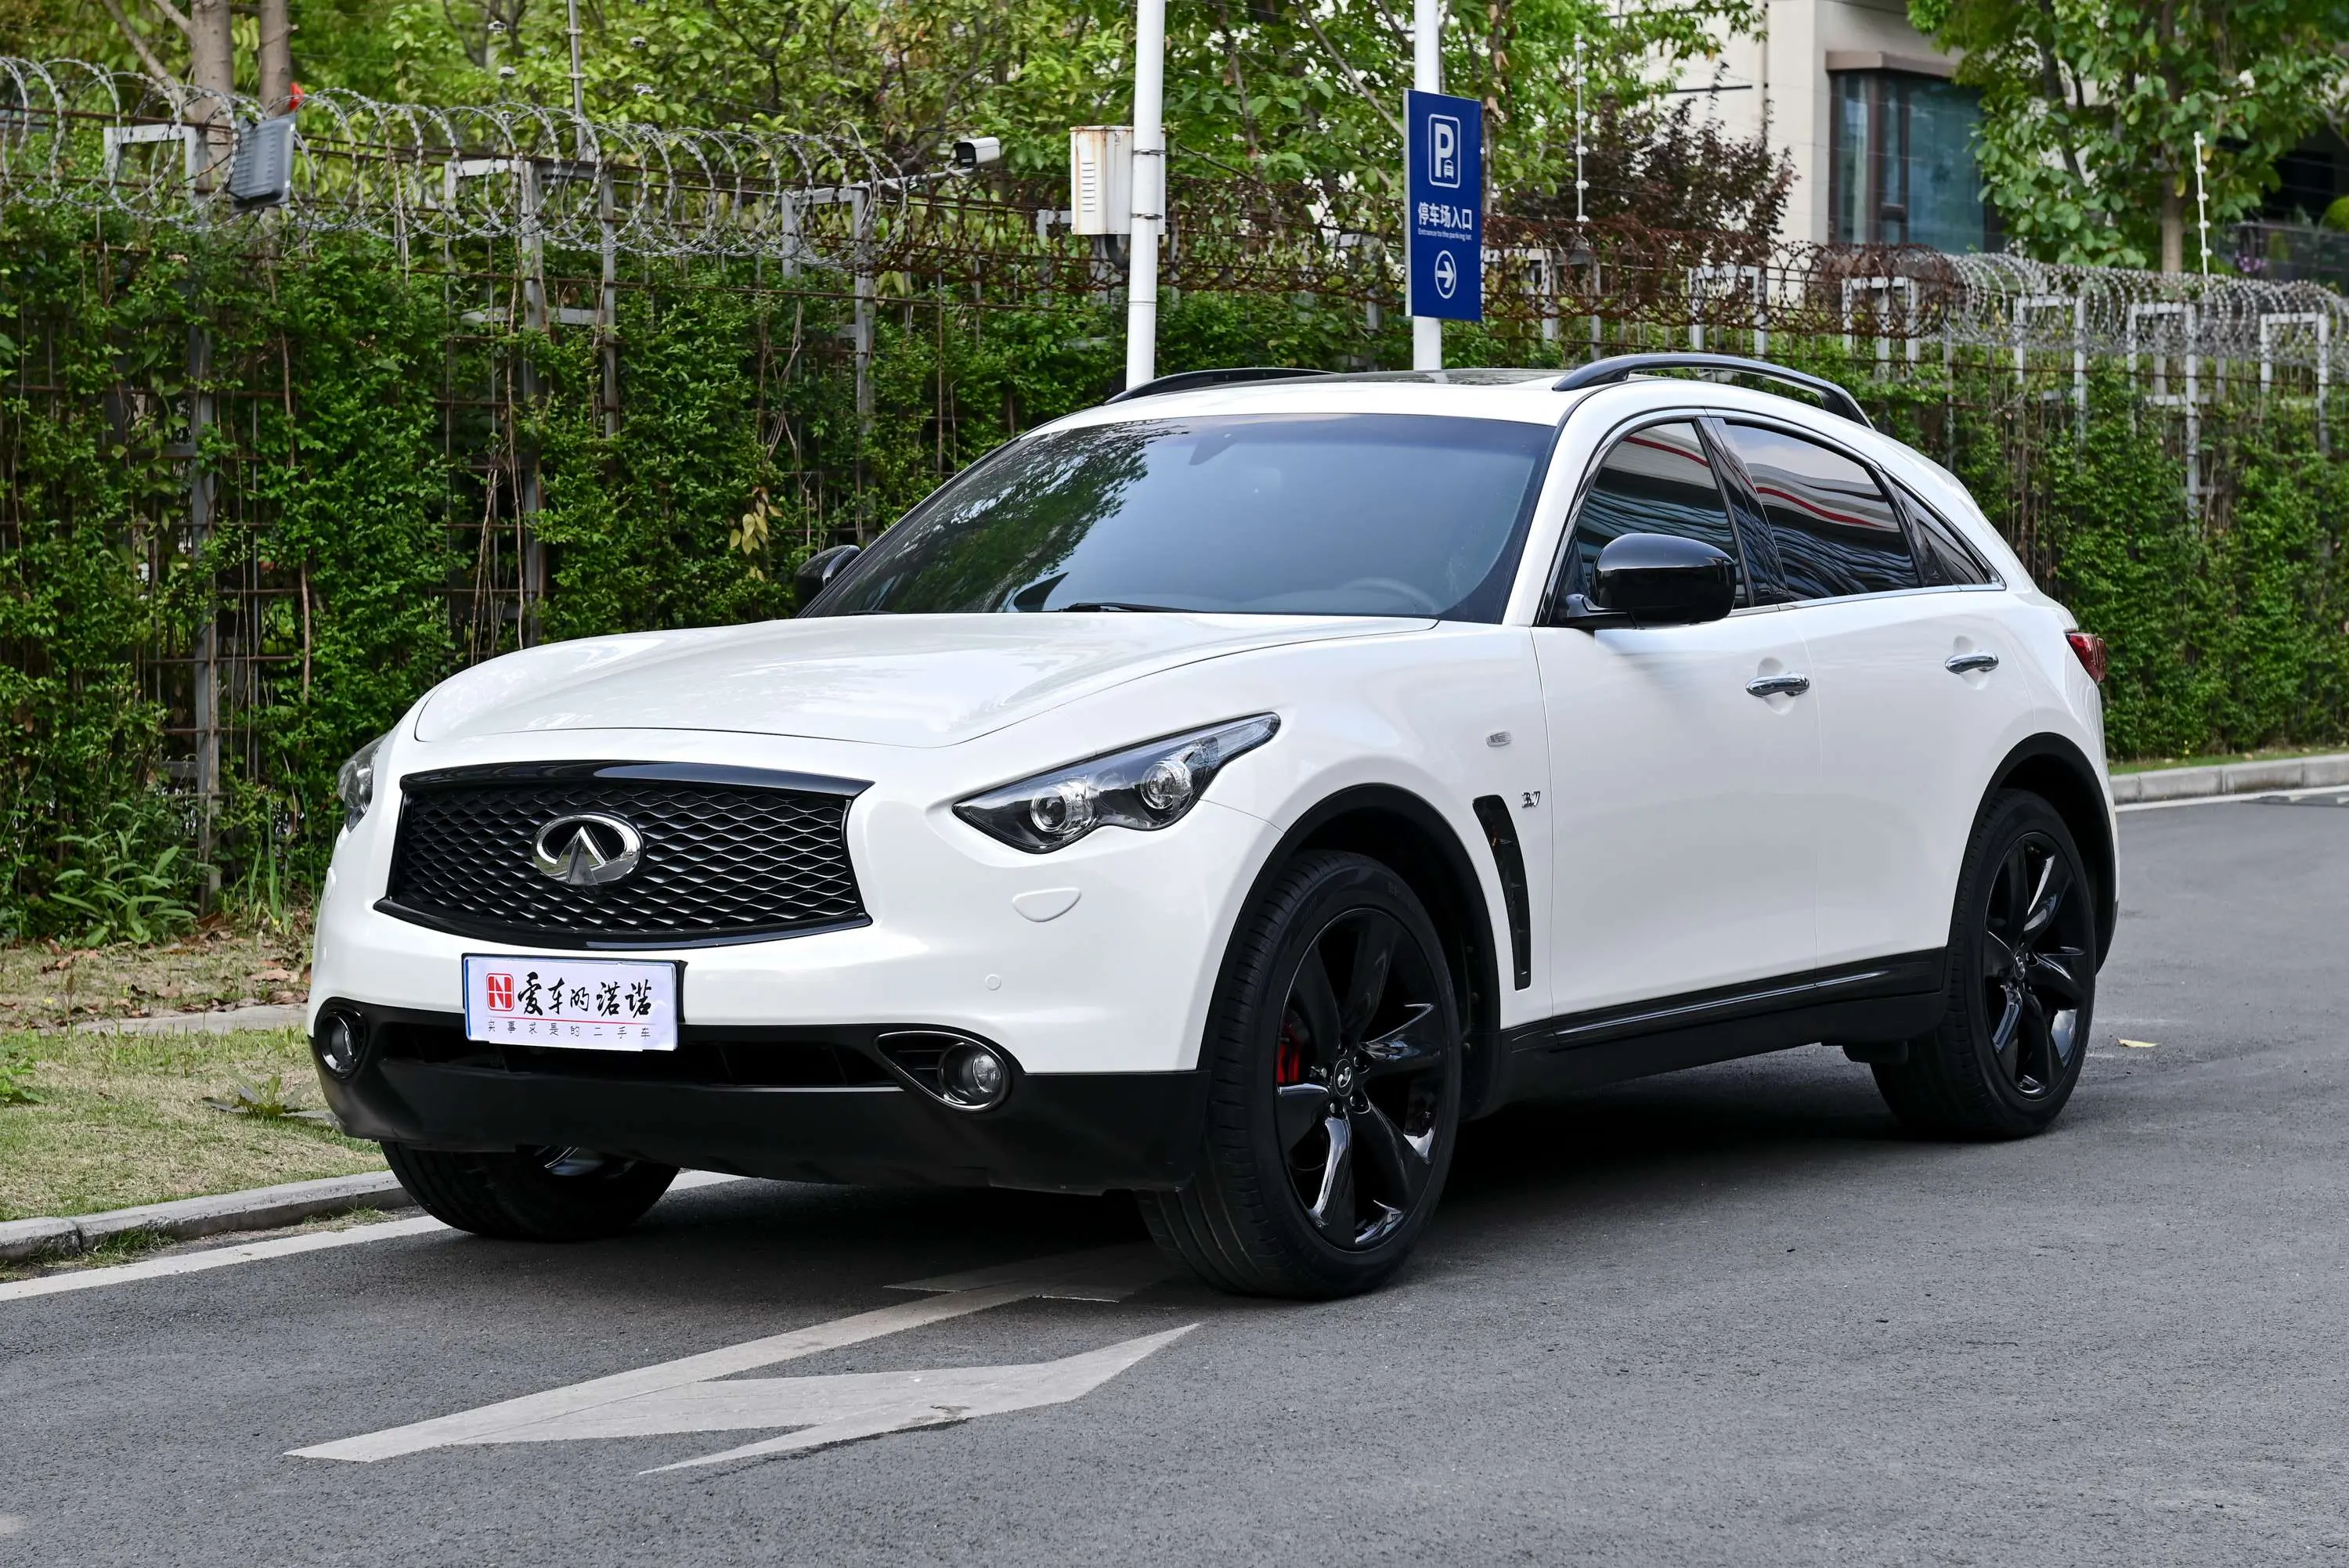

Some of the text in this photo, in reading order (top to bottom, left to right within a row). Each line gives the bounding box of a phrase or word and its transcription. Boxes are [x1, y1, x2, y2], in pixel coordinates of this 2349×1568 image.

[1434, 123, 1454, 178] P
[1418, 201, 1472, 230] 停车场入口
[517, 971, 652, 1018] 爱车的诺诺
[488, 1020, 651, 1040] 实事求是的二手车
